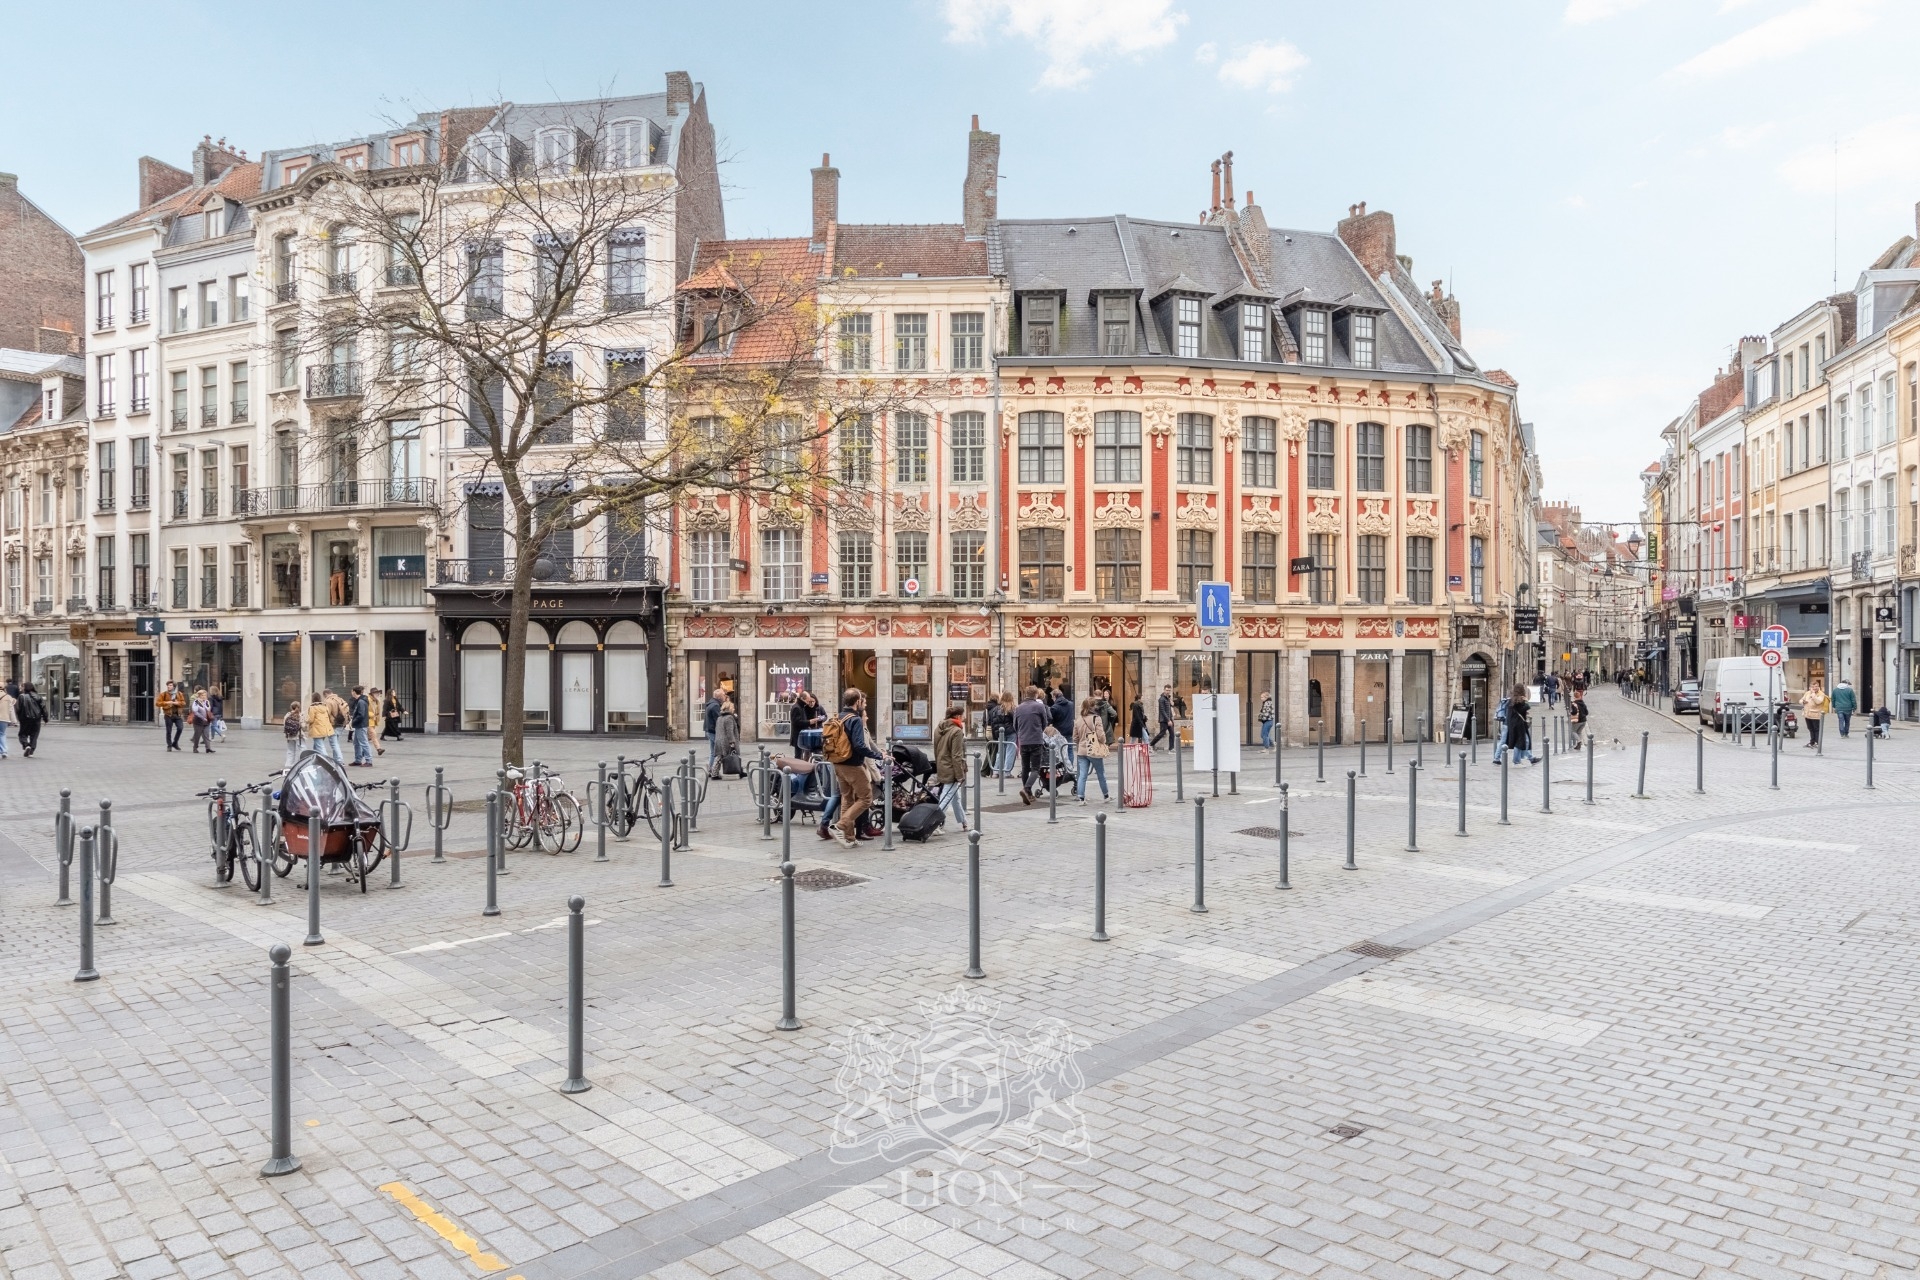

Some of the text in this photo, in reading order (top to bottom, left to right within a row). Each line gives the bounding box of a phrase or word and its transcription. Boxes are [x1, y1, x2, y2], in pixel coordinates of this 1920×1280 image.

[397, 559, 405, 570] K
[145, 621, 154, 632] K
[70, 627, 87, 638] OR
[769, 663, 810, 675] dinh van
